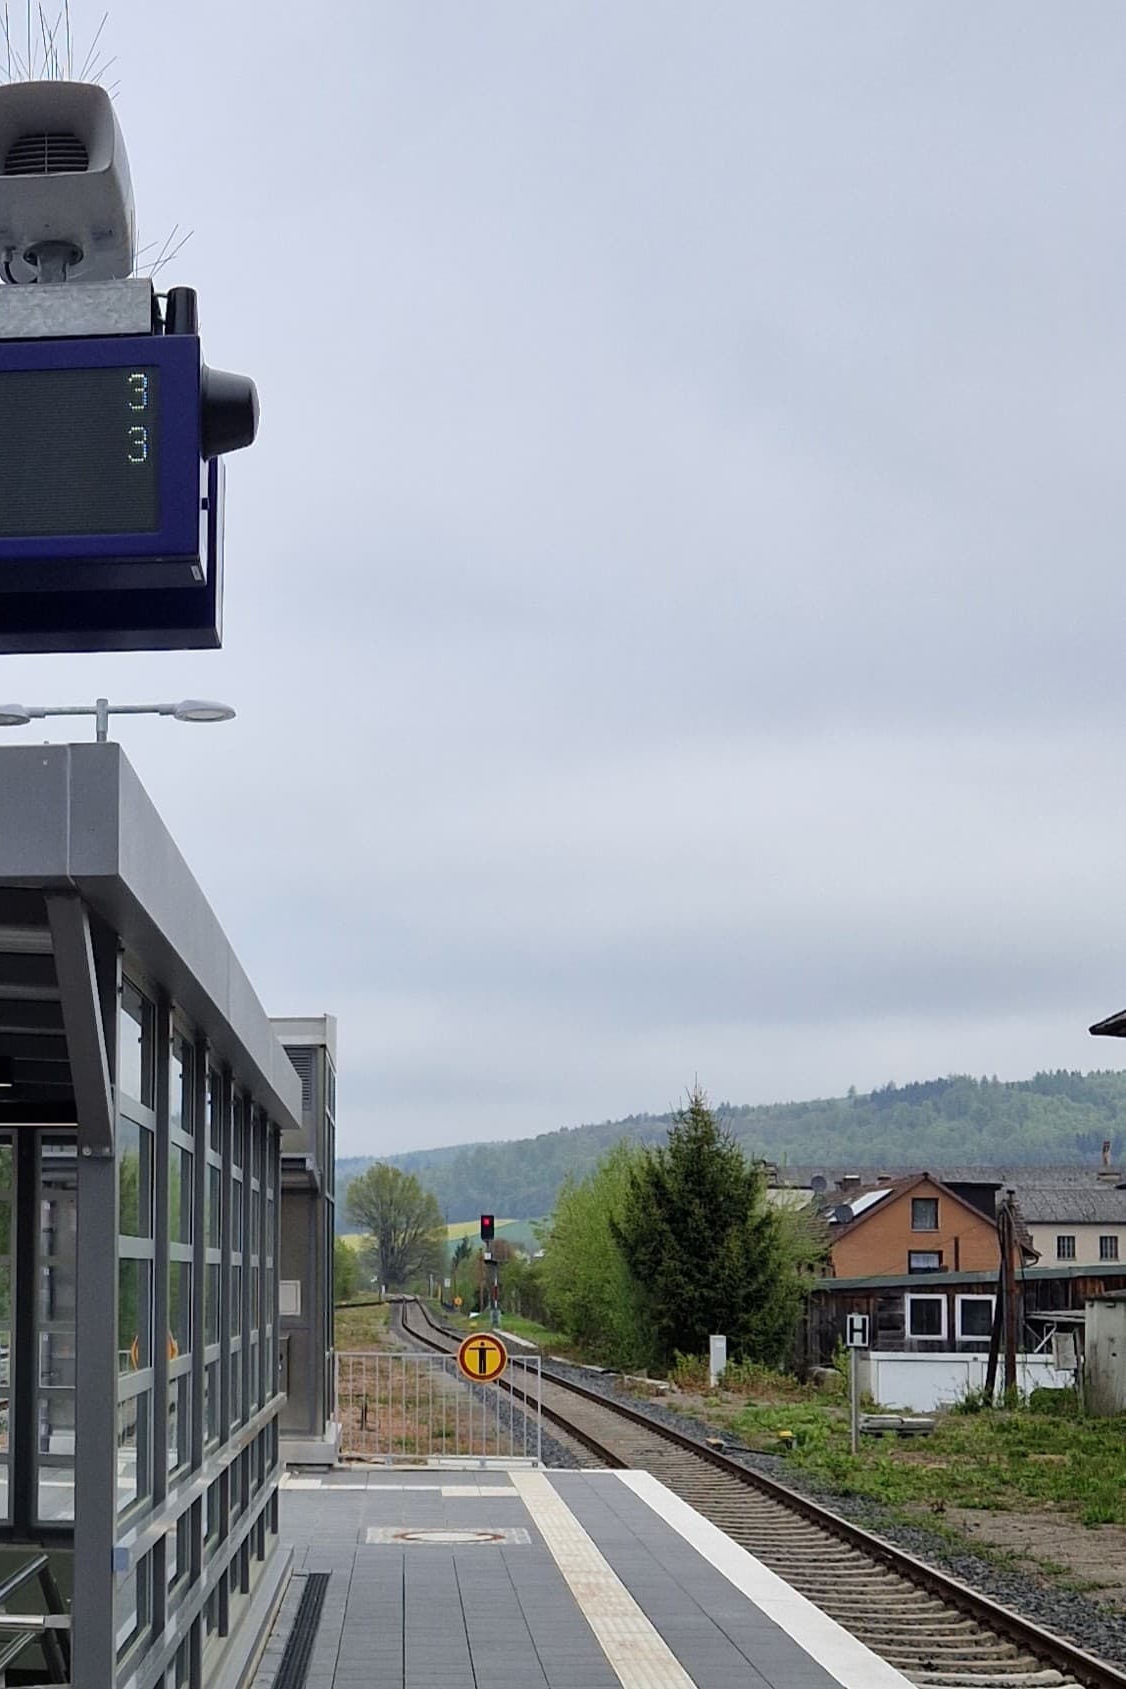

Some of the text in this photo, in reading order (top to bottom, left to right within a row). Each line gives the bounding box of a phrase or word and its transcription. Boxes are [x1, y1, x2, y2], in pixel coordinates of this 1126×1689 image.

[128, 373, 149, 410] 3
[128, 426, 149, 463] 3
[849, 1317, 867, 1344] H
